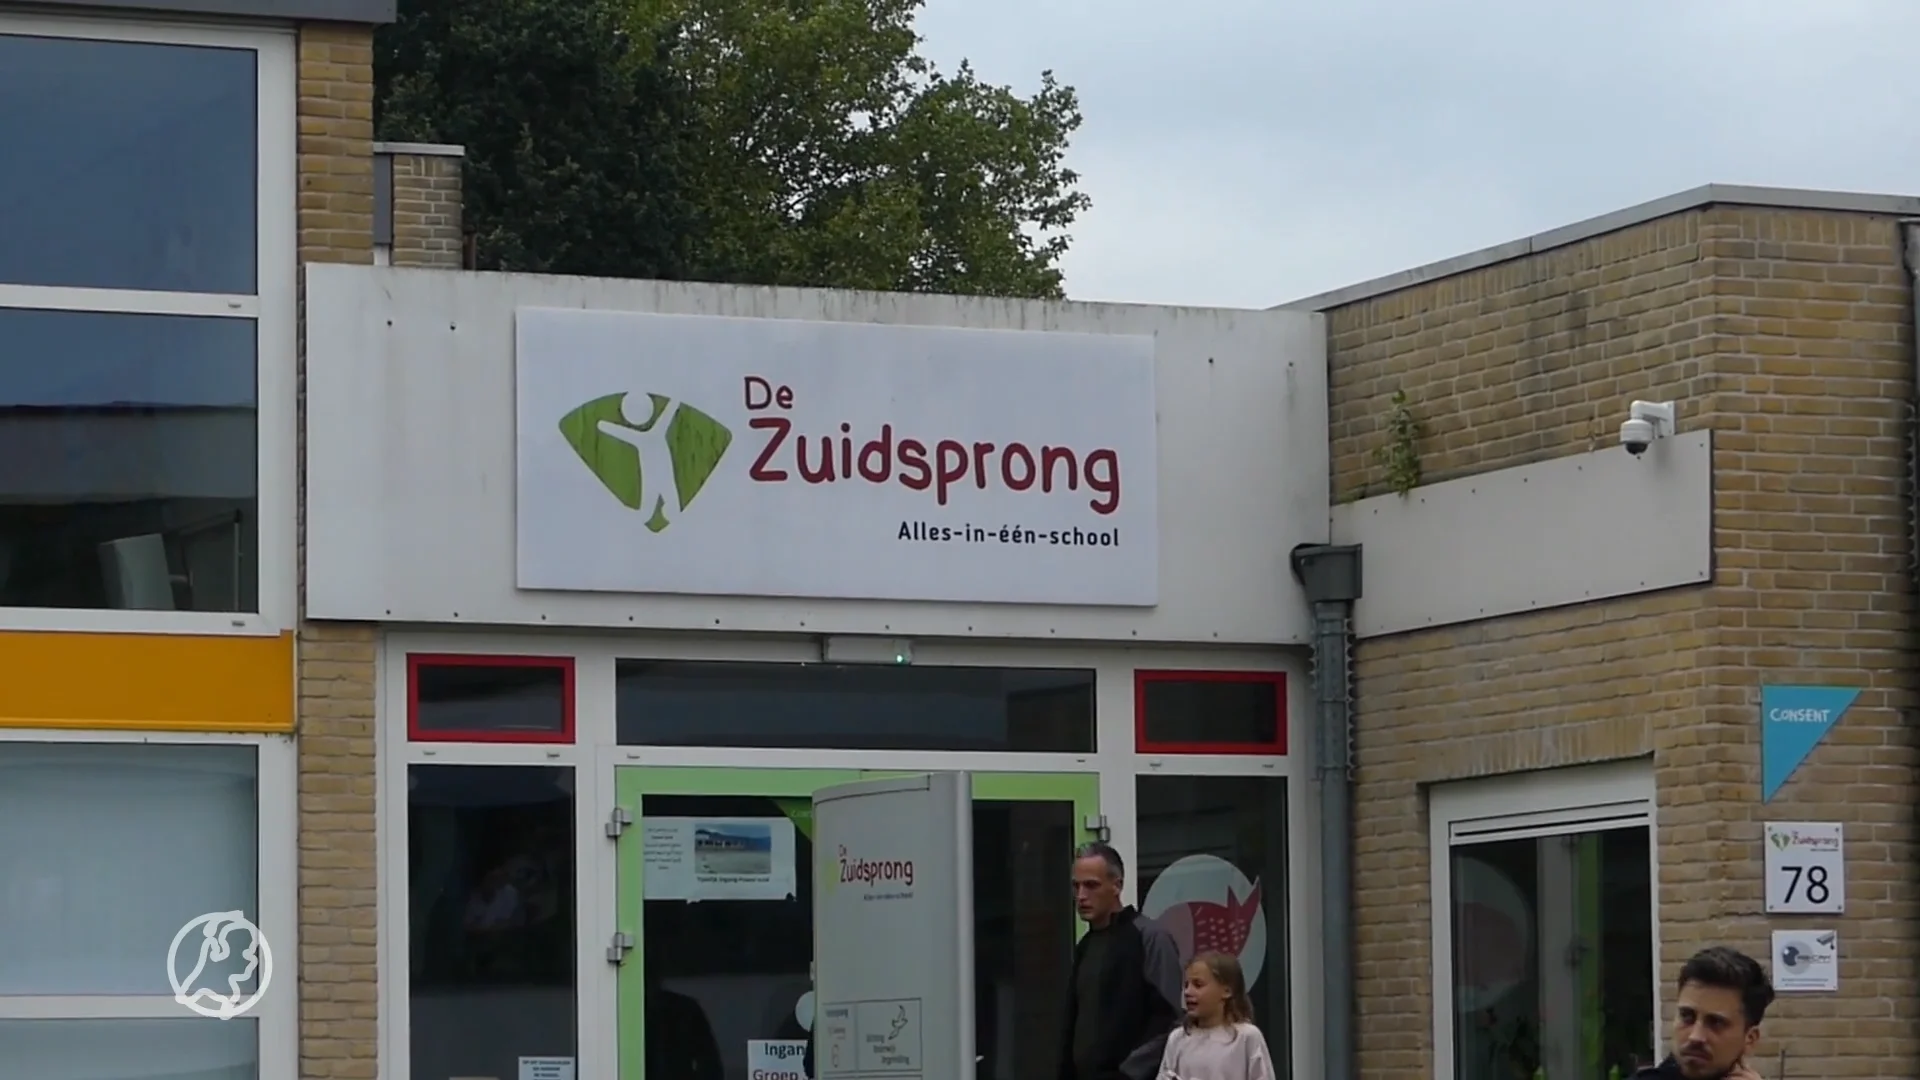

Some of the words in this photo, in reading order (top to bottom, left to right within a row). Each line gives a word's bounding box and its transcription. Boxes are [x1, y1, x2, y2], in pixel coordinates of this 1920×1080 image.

[744, 376, 794, 410] De
[748, 417, 1121, 515] Zuidsprong
[897, 521, 1120, 547] Alles-in-één-school
[1770, 707, 1832, 724] CONSENT
[840, 857, 914, 887] Zuidsprong
[1781, 865, 1829, 904] 78
[764, 1042, 807, 1060] Ingan
